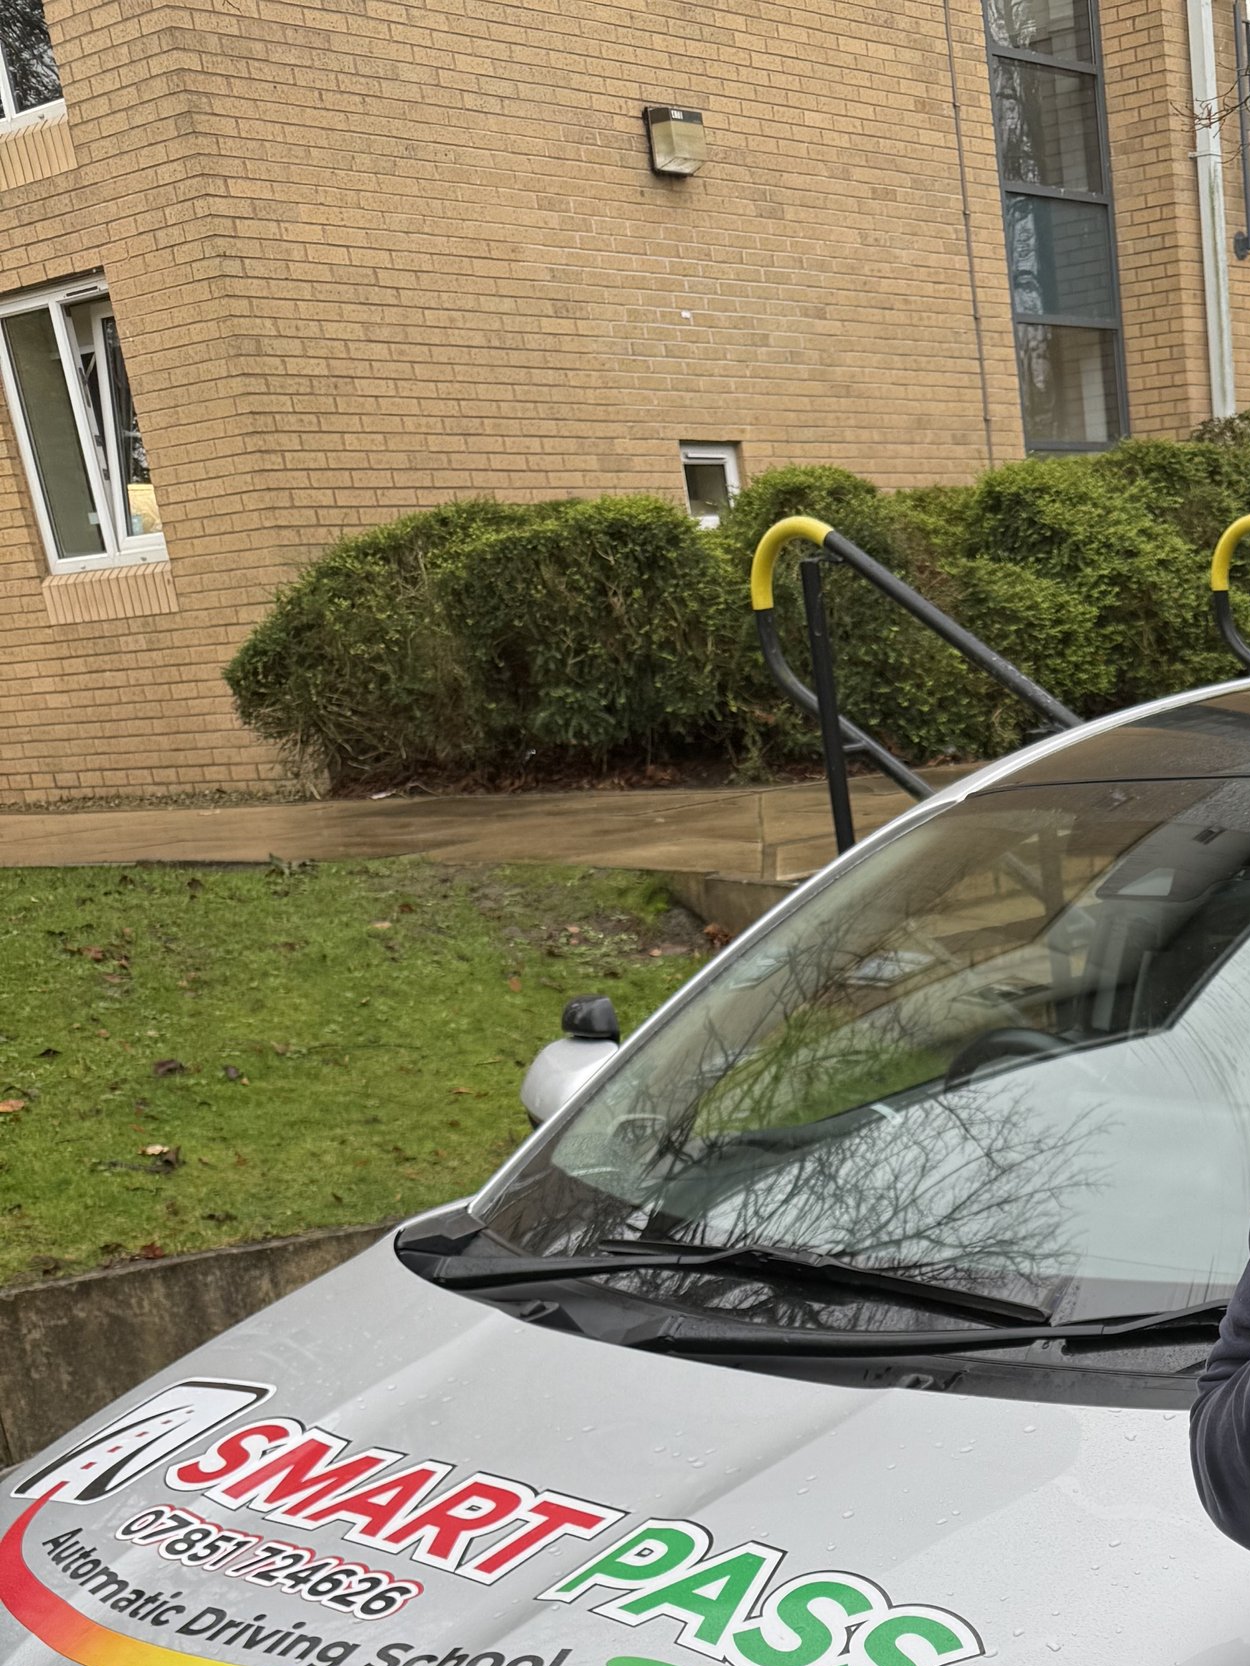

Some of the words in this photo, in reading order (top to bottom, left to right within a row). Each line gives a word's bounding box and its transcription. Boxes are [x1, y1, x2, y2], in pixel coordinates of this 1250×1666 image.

[169, 1420, 616, 1580] SMART
[42, 1527, 185, 1627] Automatic
[119, 1507, 253, 1569] 07851
[231, 1542, 416, 1618] 724626
